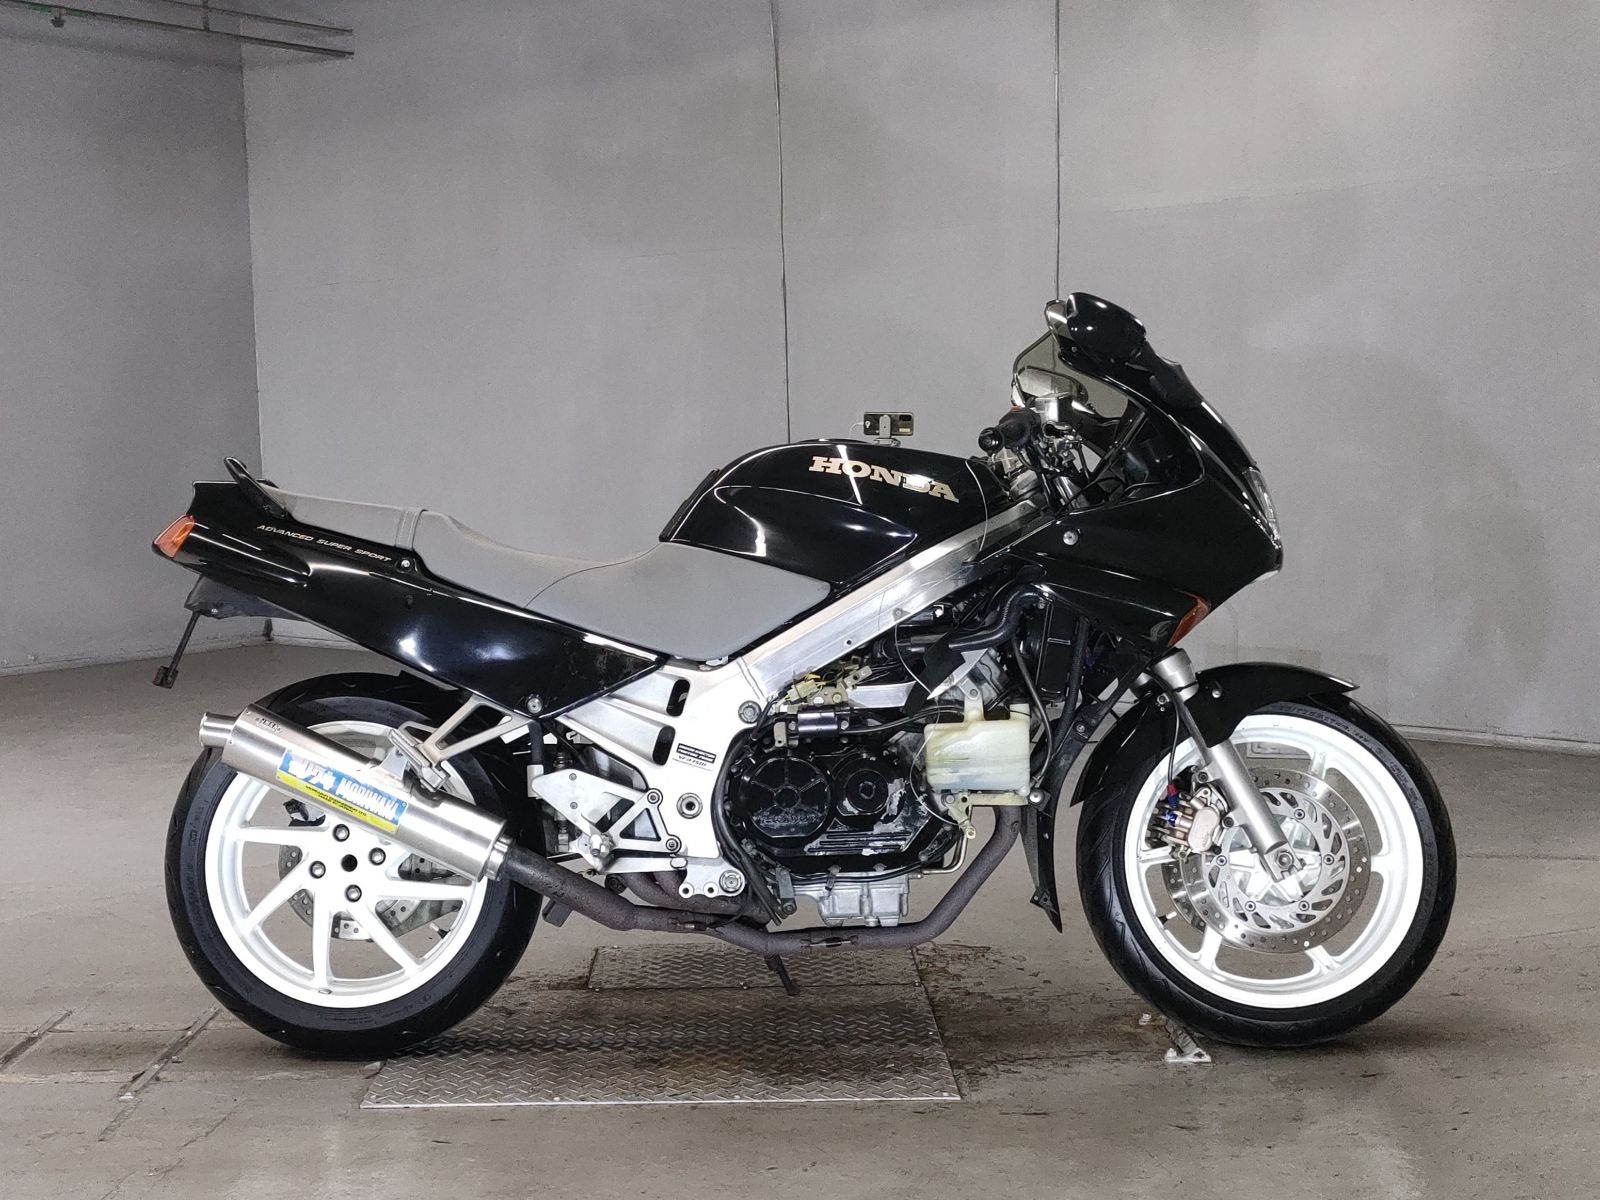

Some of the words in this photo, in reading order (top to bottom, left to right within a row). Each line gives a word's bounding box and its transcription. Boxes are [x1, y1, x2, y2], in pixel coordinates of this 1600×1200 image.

[809, 456, 959, 503] HONDA
[257, 525, 314, 542] ADVANCED
[316, 538, 353, 551] SUPER
[354, 549, 392, 562] SPORT
